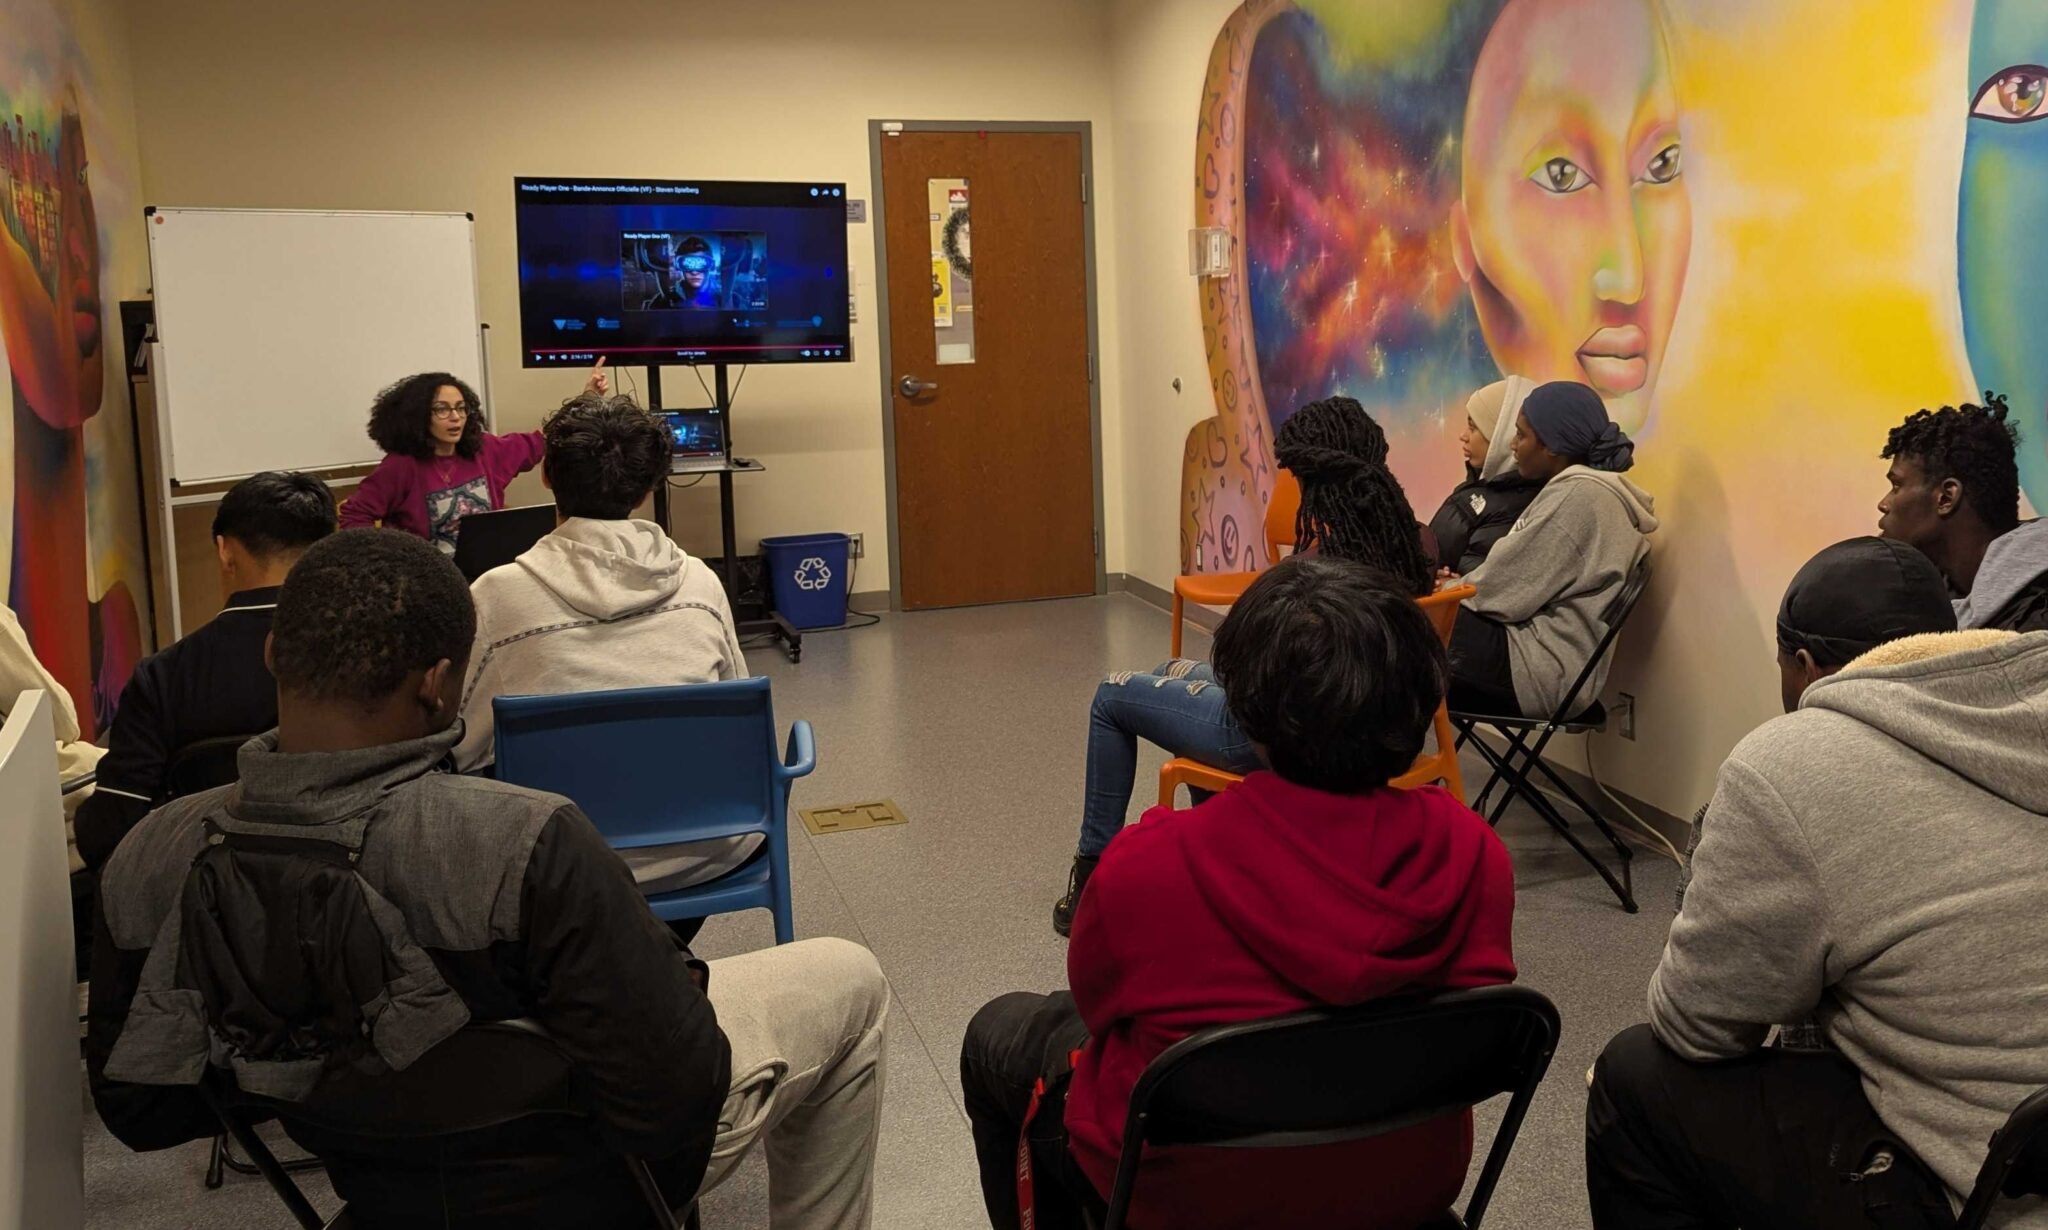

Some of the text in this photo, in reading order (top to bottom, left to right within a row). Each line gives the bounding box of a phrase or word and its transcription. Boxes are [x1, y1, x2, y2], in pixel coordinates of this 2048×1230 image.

[521, 184, 539, 193] Ready
[540, 184, 557, 192] Player
[558, 184, 570, 192] One
[640, 185, 652, 194] (VF)
